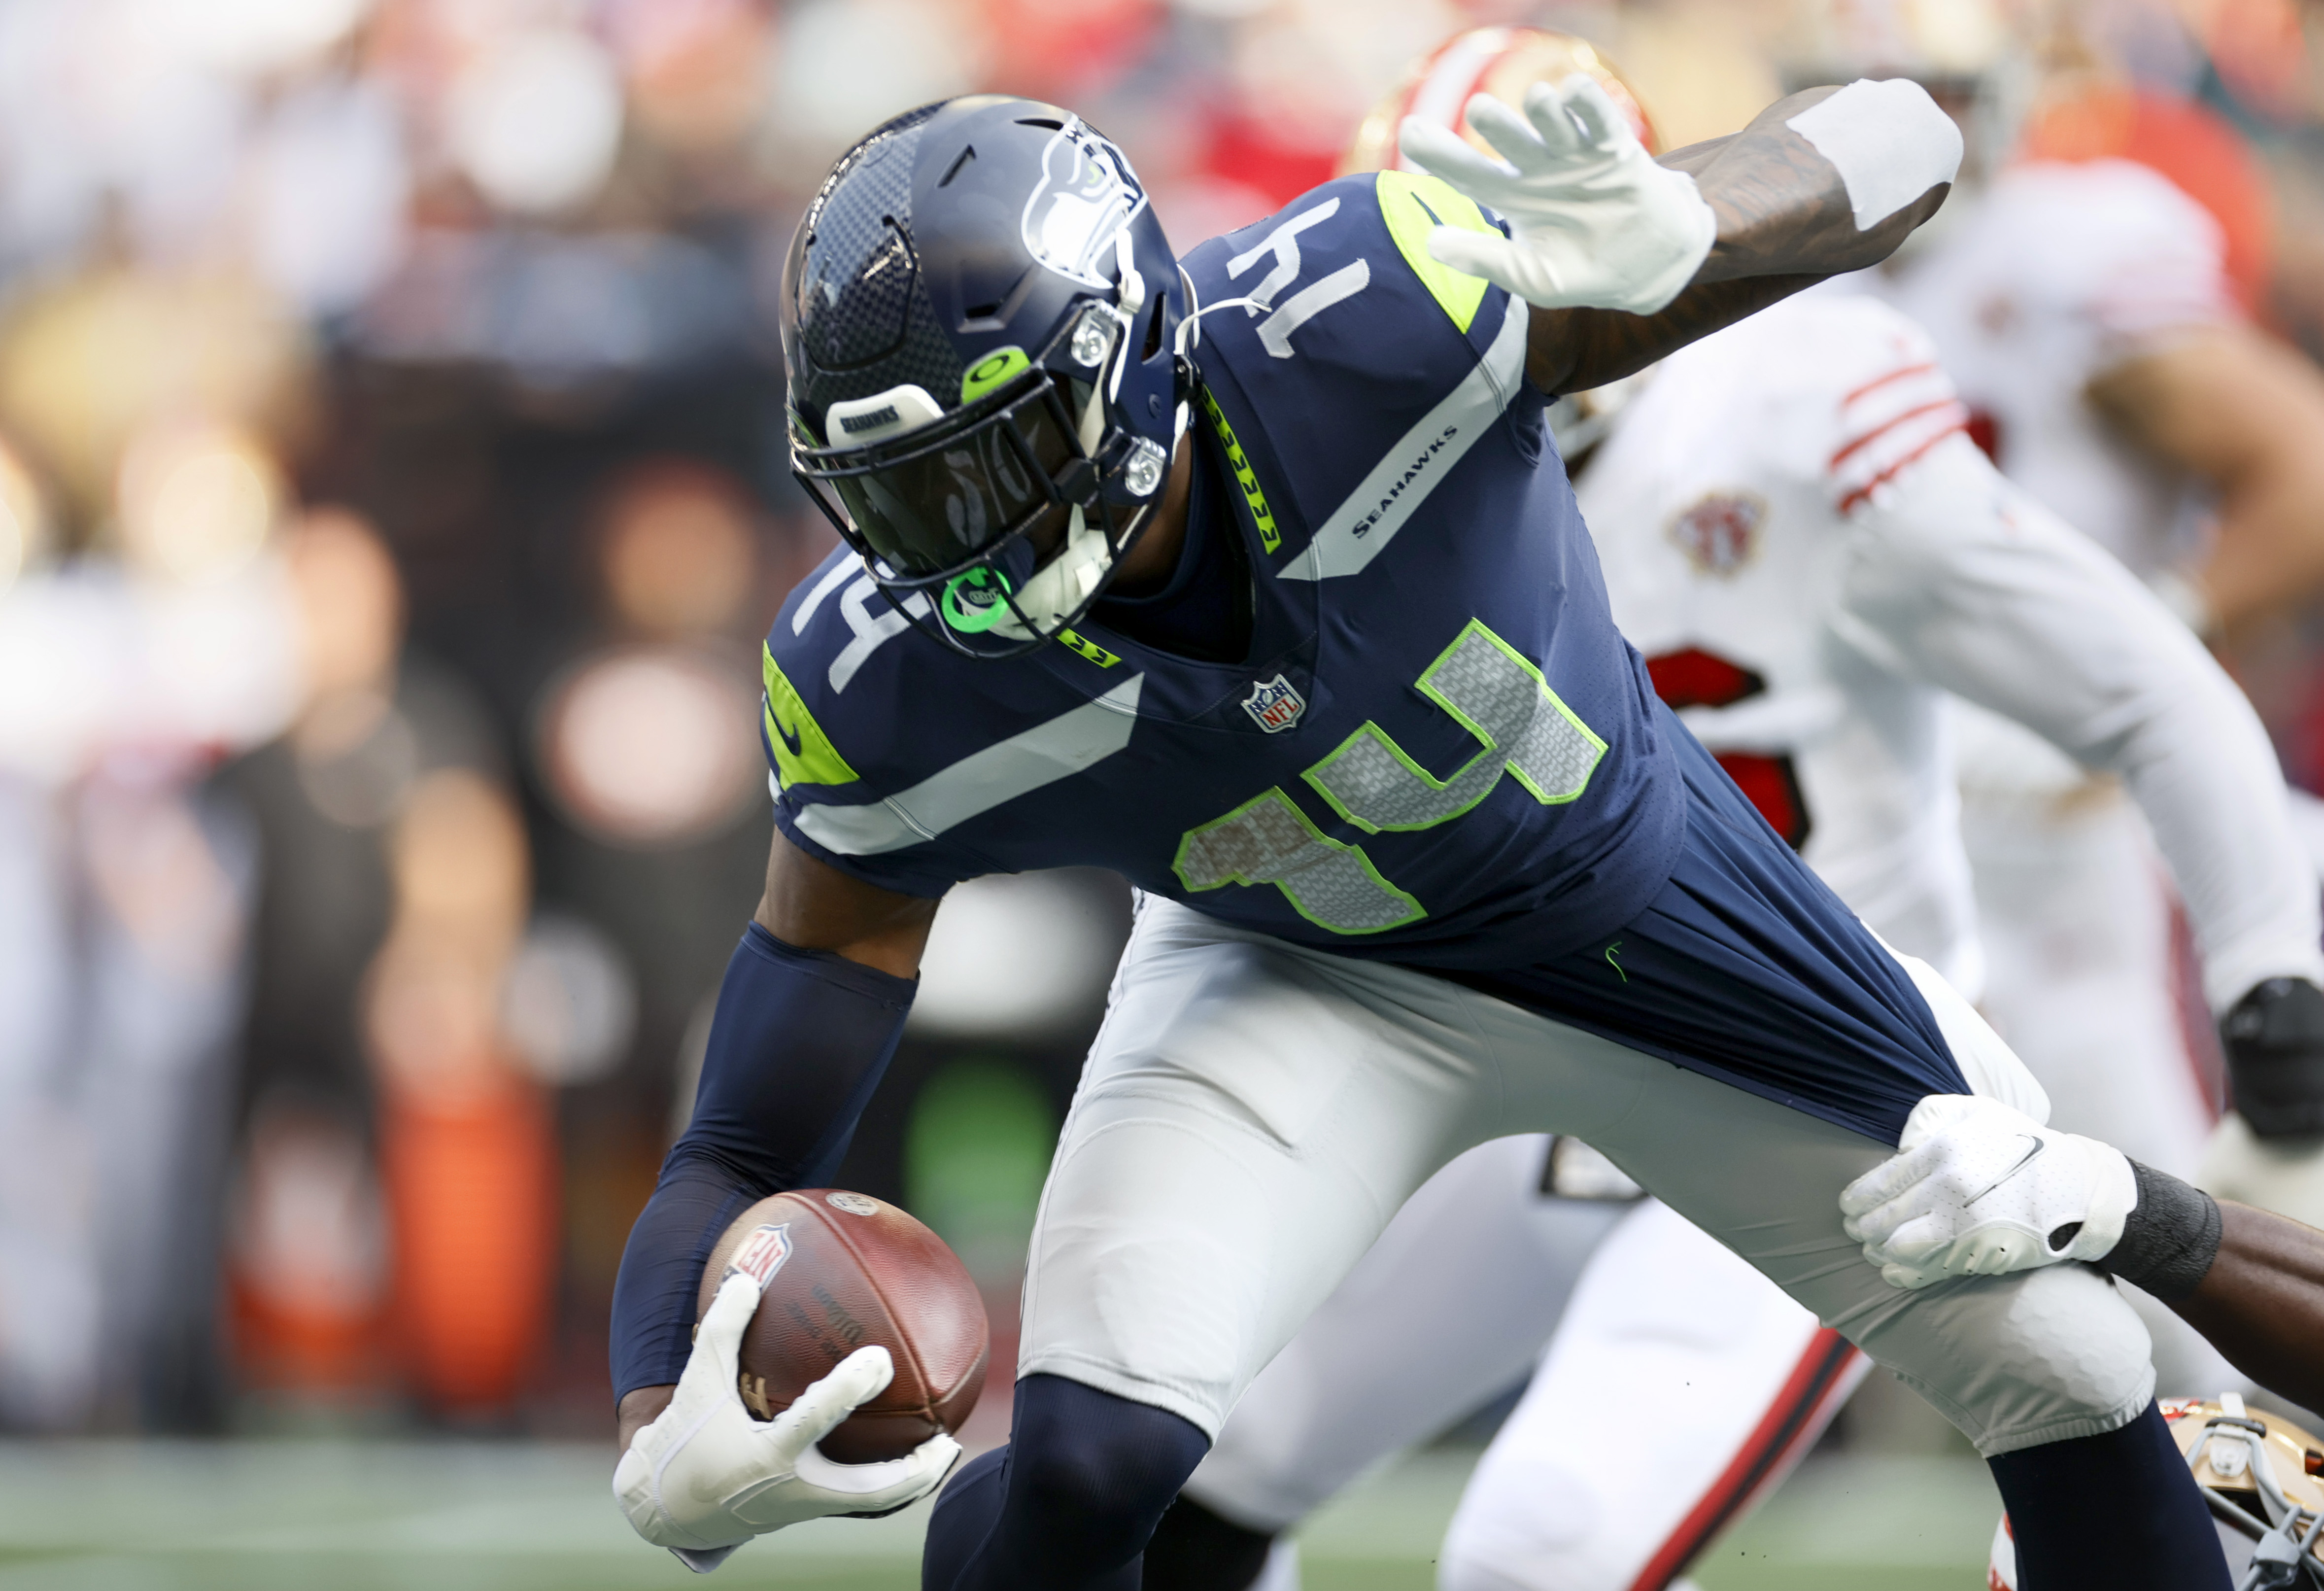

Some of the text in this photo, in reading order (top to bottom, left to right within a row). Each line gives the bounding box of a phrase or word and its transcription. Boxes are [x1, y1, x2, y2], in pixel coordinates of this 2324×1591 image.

[1226, 196, 1371, 359] 14
[840, 405, 900, 434] SEAHAWKS
[1352, 425, 1458, 540] SEAHAWKS
[1262, 698, 1299, 726] NFL
[1170, 617, 1608, 935] 14
[737, 1232, 783, 1283] NFL
